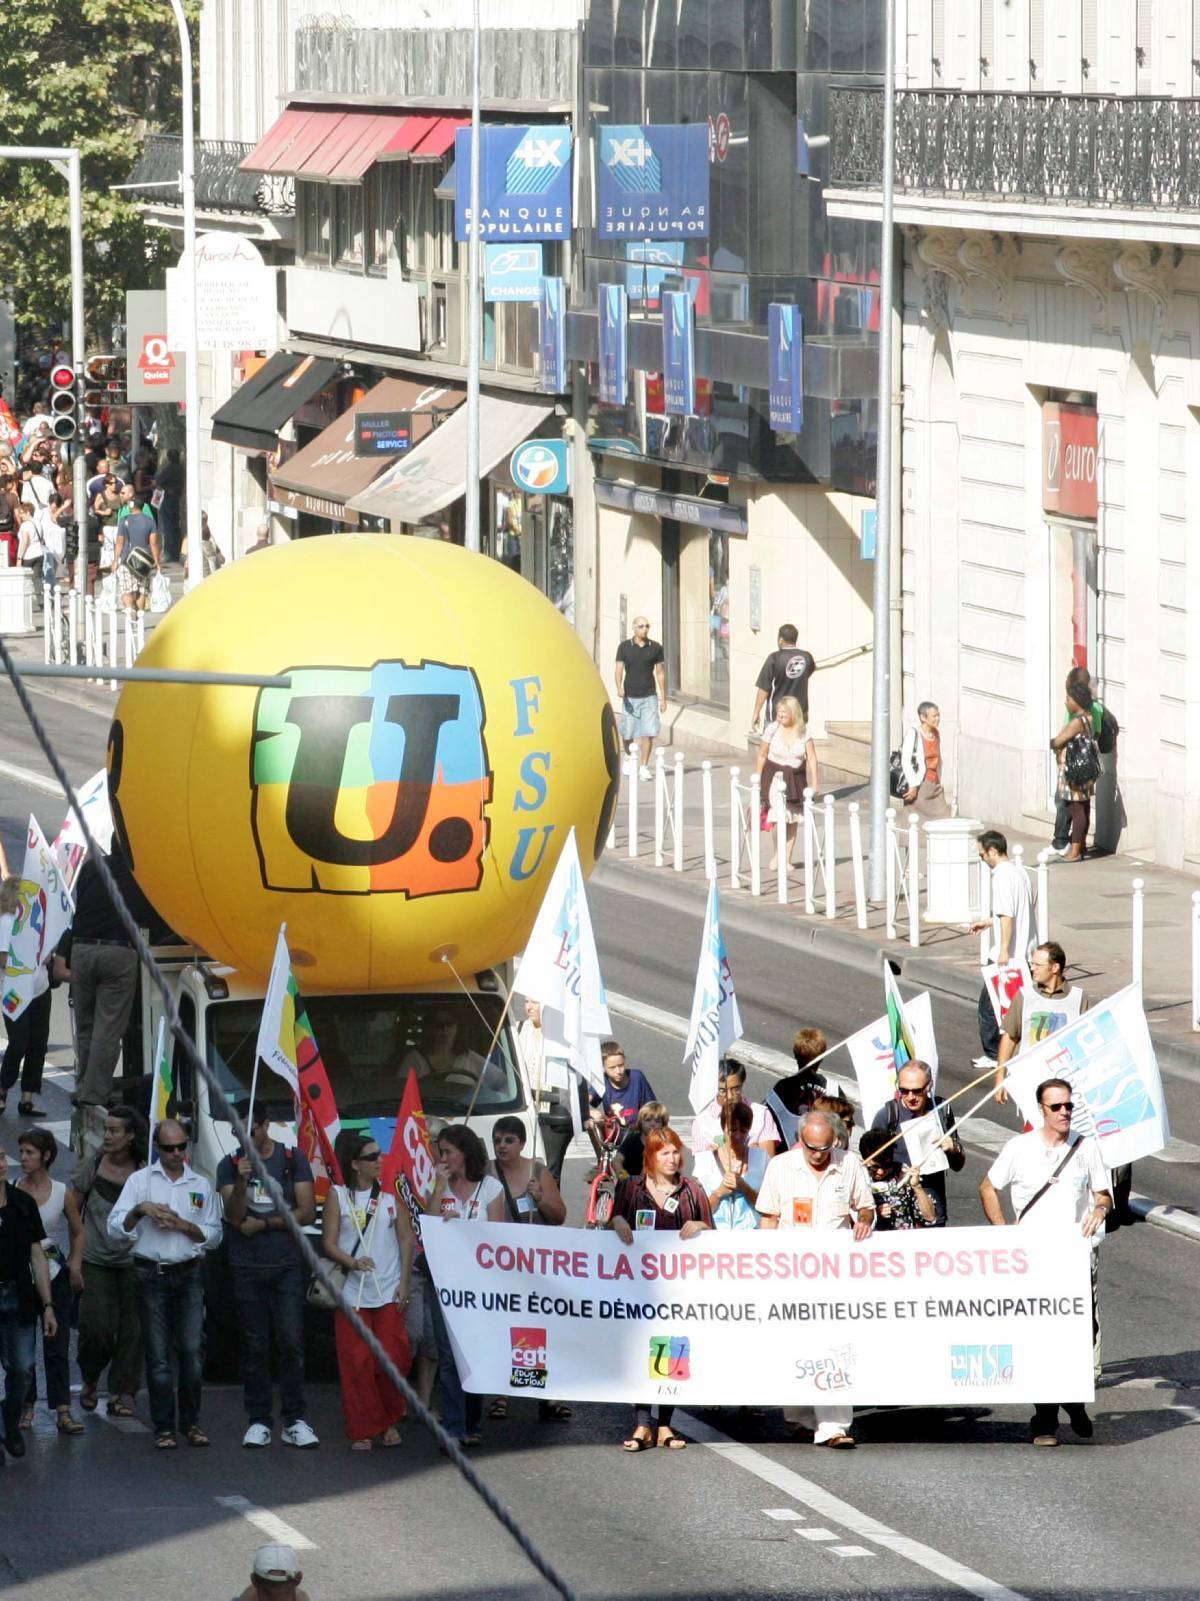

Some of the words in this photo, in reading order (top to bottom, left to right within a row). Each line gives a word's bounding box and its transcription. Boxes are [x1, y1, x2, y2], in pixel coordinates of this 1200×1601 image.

[465, 207, 562, 218] BANQUE
[465, 222, 562, 234] POPULAIRE
[491, 286, 540, 296] CHANGE
[144, 371, 169, 380] Quick
[376, 440, 408, 449] SERVICE
[475, 1243, 589, 1279] CONTRE
[597, 1253, 634, 1281] LA
[641, 1252, 840, 1281] SUPPRESSION
[849, 1251, 906, 1280] DES
[915, 1248, 1030, 1277] POSTES
[482, 1292, 521, 1312] UNE
[528, 1291, 593, 1318] ÉCOLE
[599, 1297, 763, 1323] DÉMOCRATIQUE,
[767, 1302, 888, 1321] AMBITIEUSE
[895, 1301, 919, 1319] ET
[925, 1296, 1085, 1318] ÉMANCIPATRICE
[511, 1346, 547, 1367] cgt
